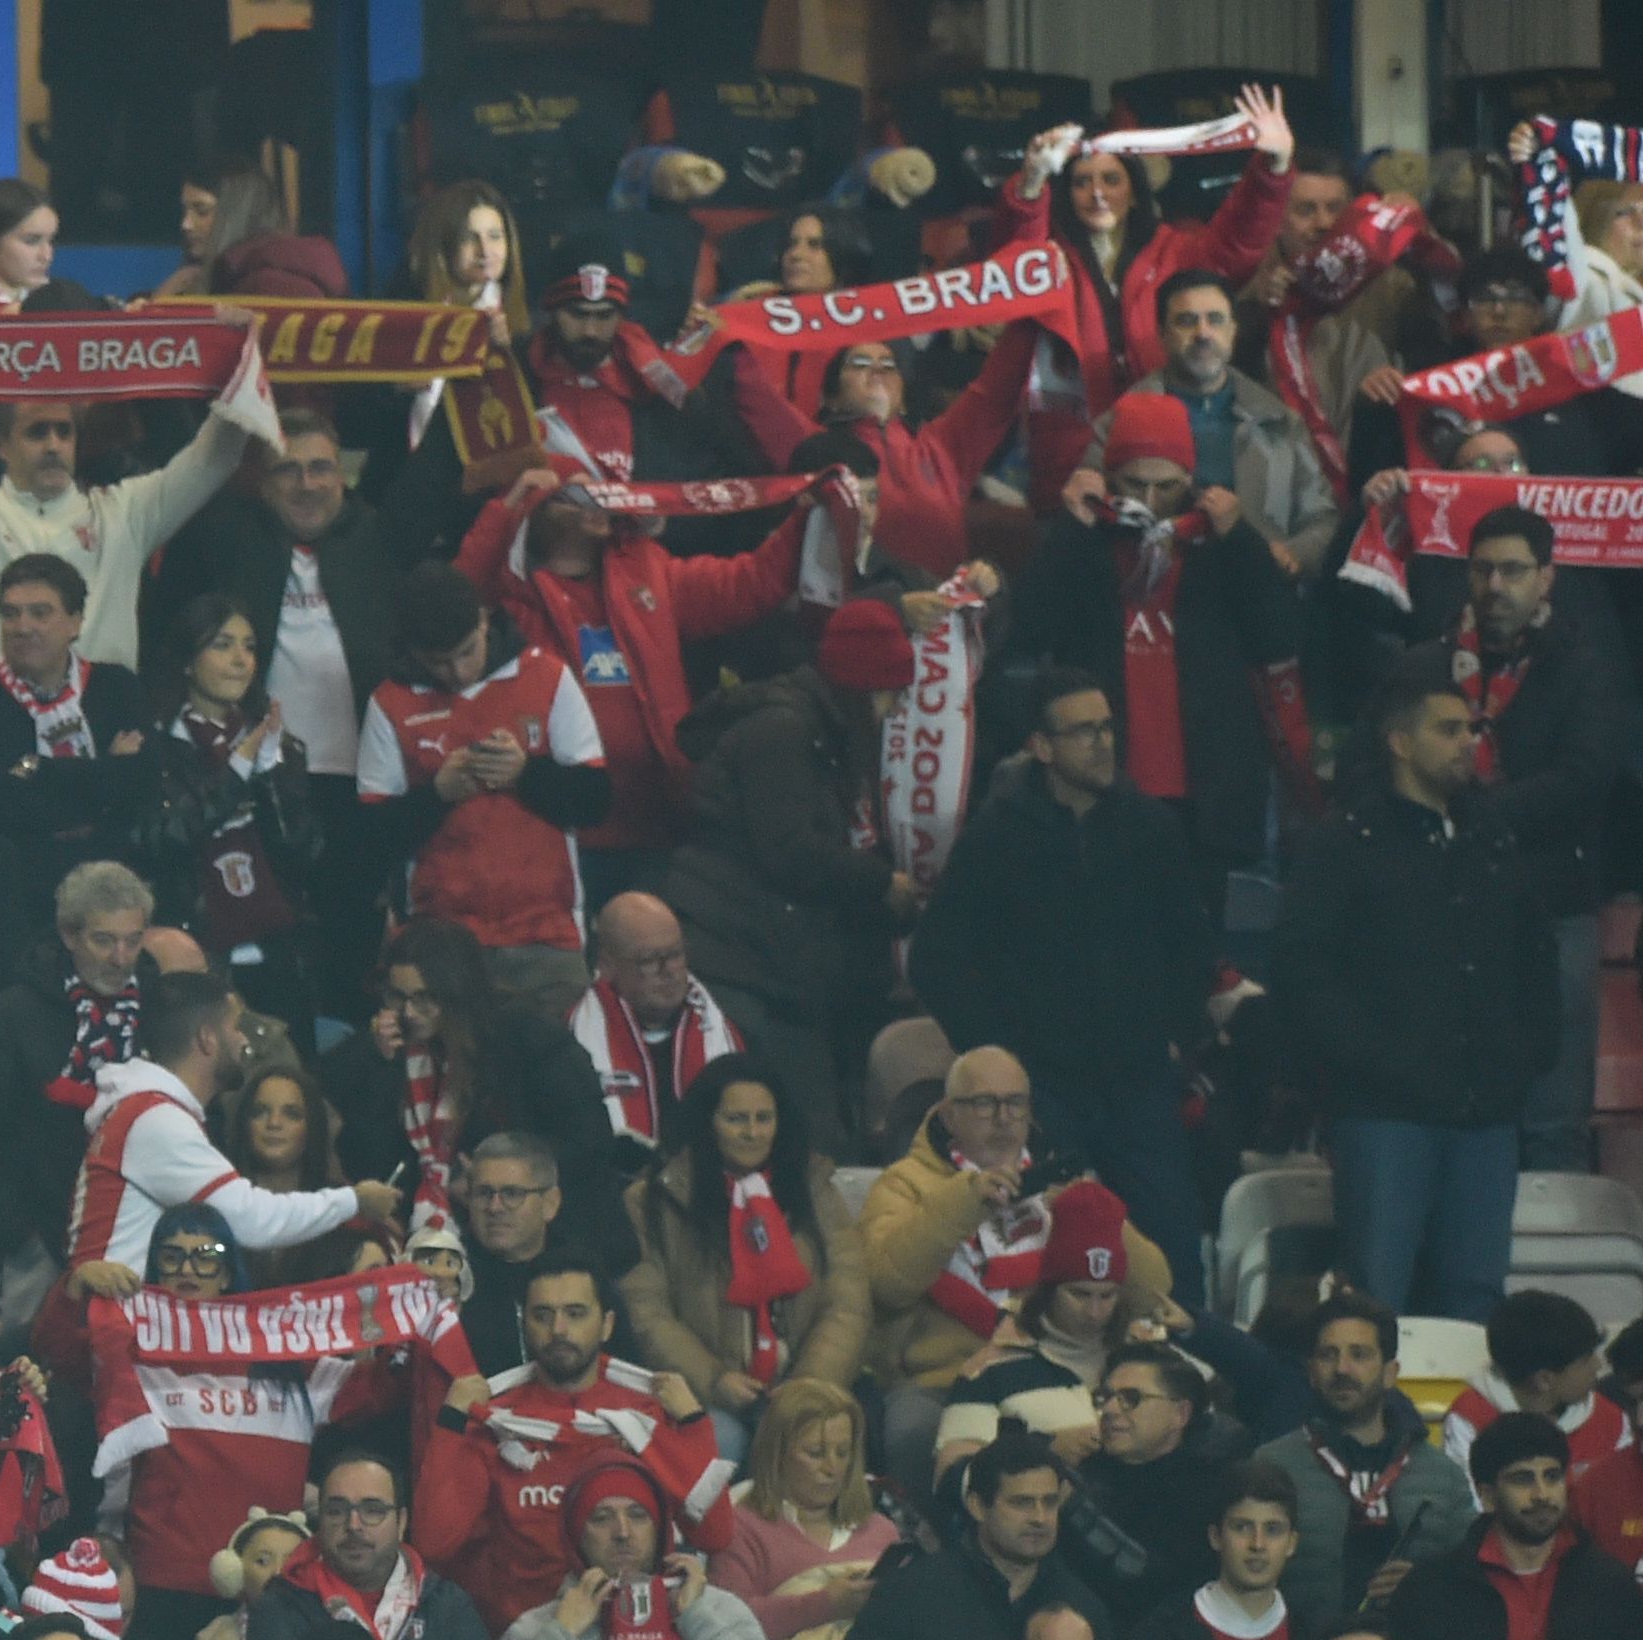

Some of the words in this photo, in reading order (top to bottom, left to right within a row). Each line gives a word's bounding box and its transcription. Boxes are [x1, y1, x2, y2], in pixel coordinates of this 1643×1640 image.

[764, 289, 885, 335] S.C.
[77, 336, 202, 372] BRAGA
[265, 313, 383, 366] AGA
